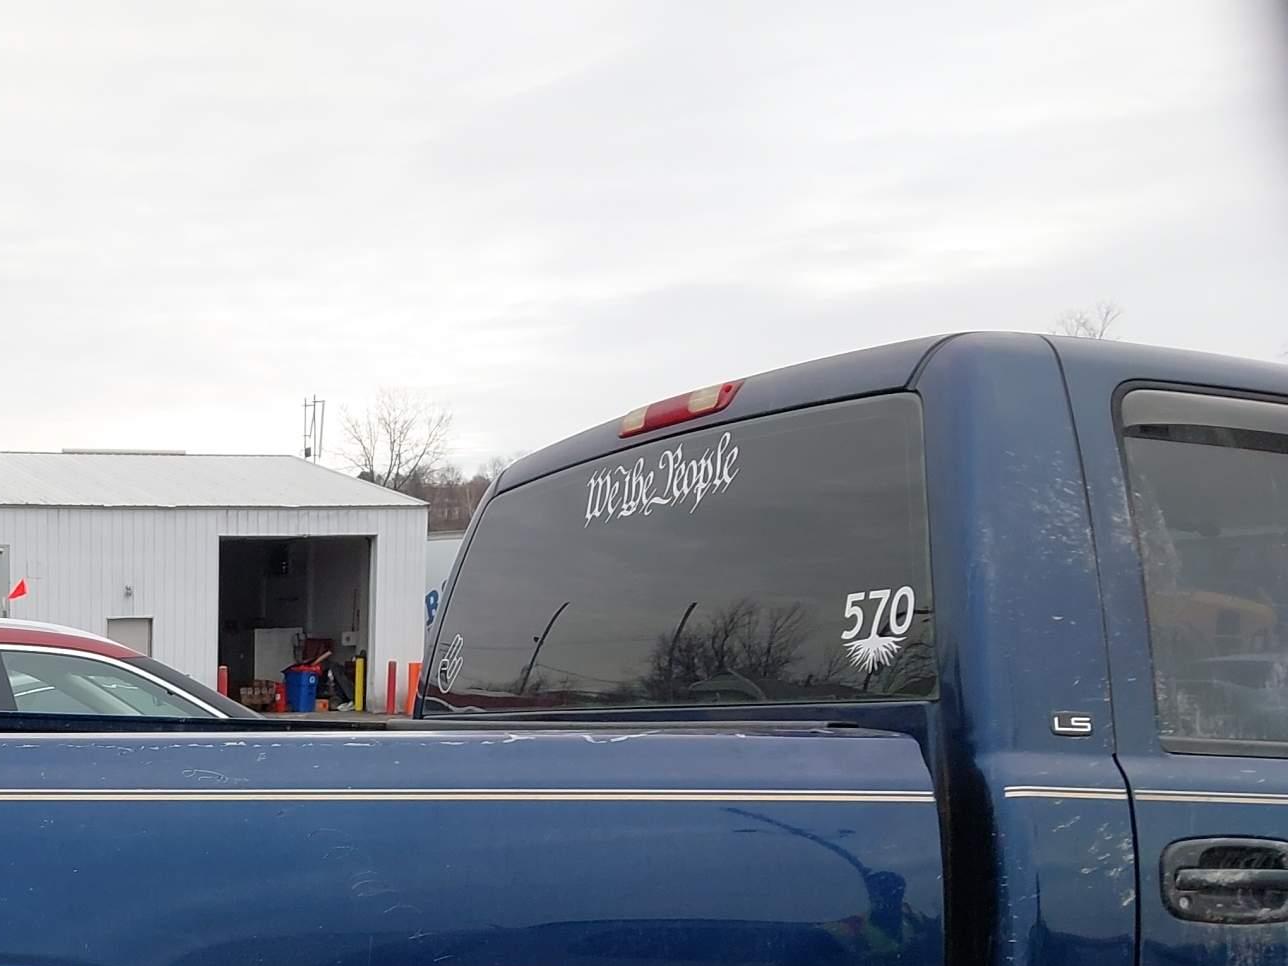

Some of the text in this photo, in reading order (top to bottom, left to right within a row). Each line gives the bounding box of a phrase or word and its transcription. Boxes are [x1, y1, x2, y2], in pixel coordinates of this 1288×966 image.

[585, 467, 622, 528] We
[645, 432, 740, 514] People
[840, 585, 916, 640] 570
[1053, 716, 1092, 732] LS
